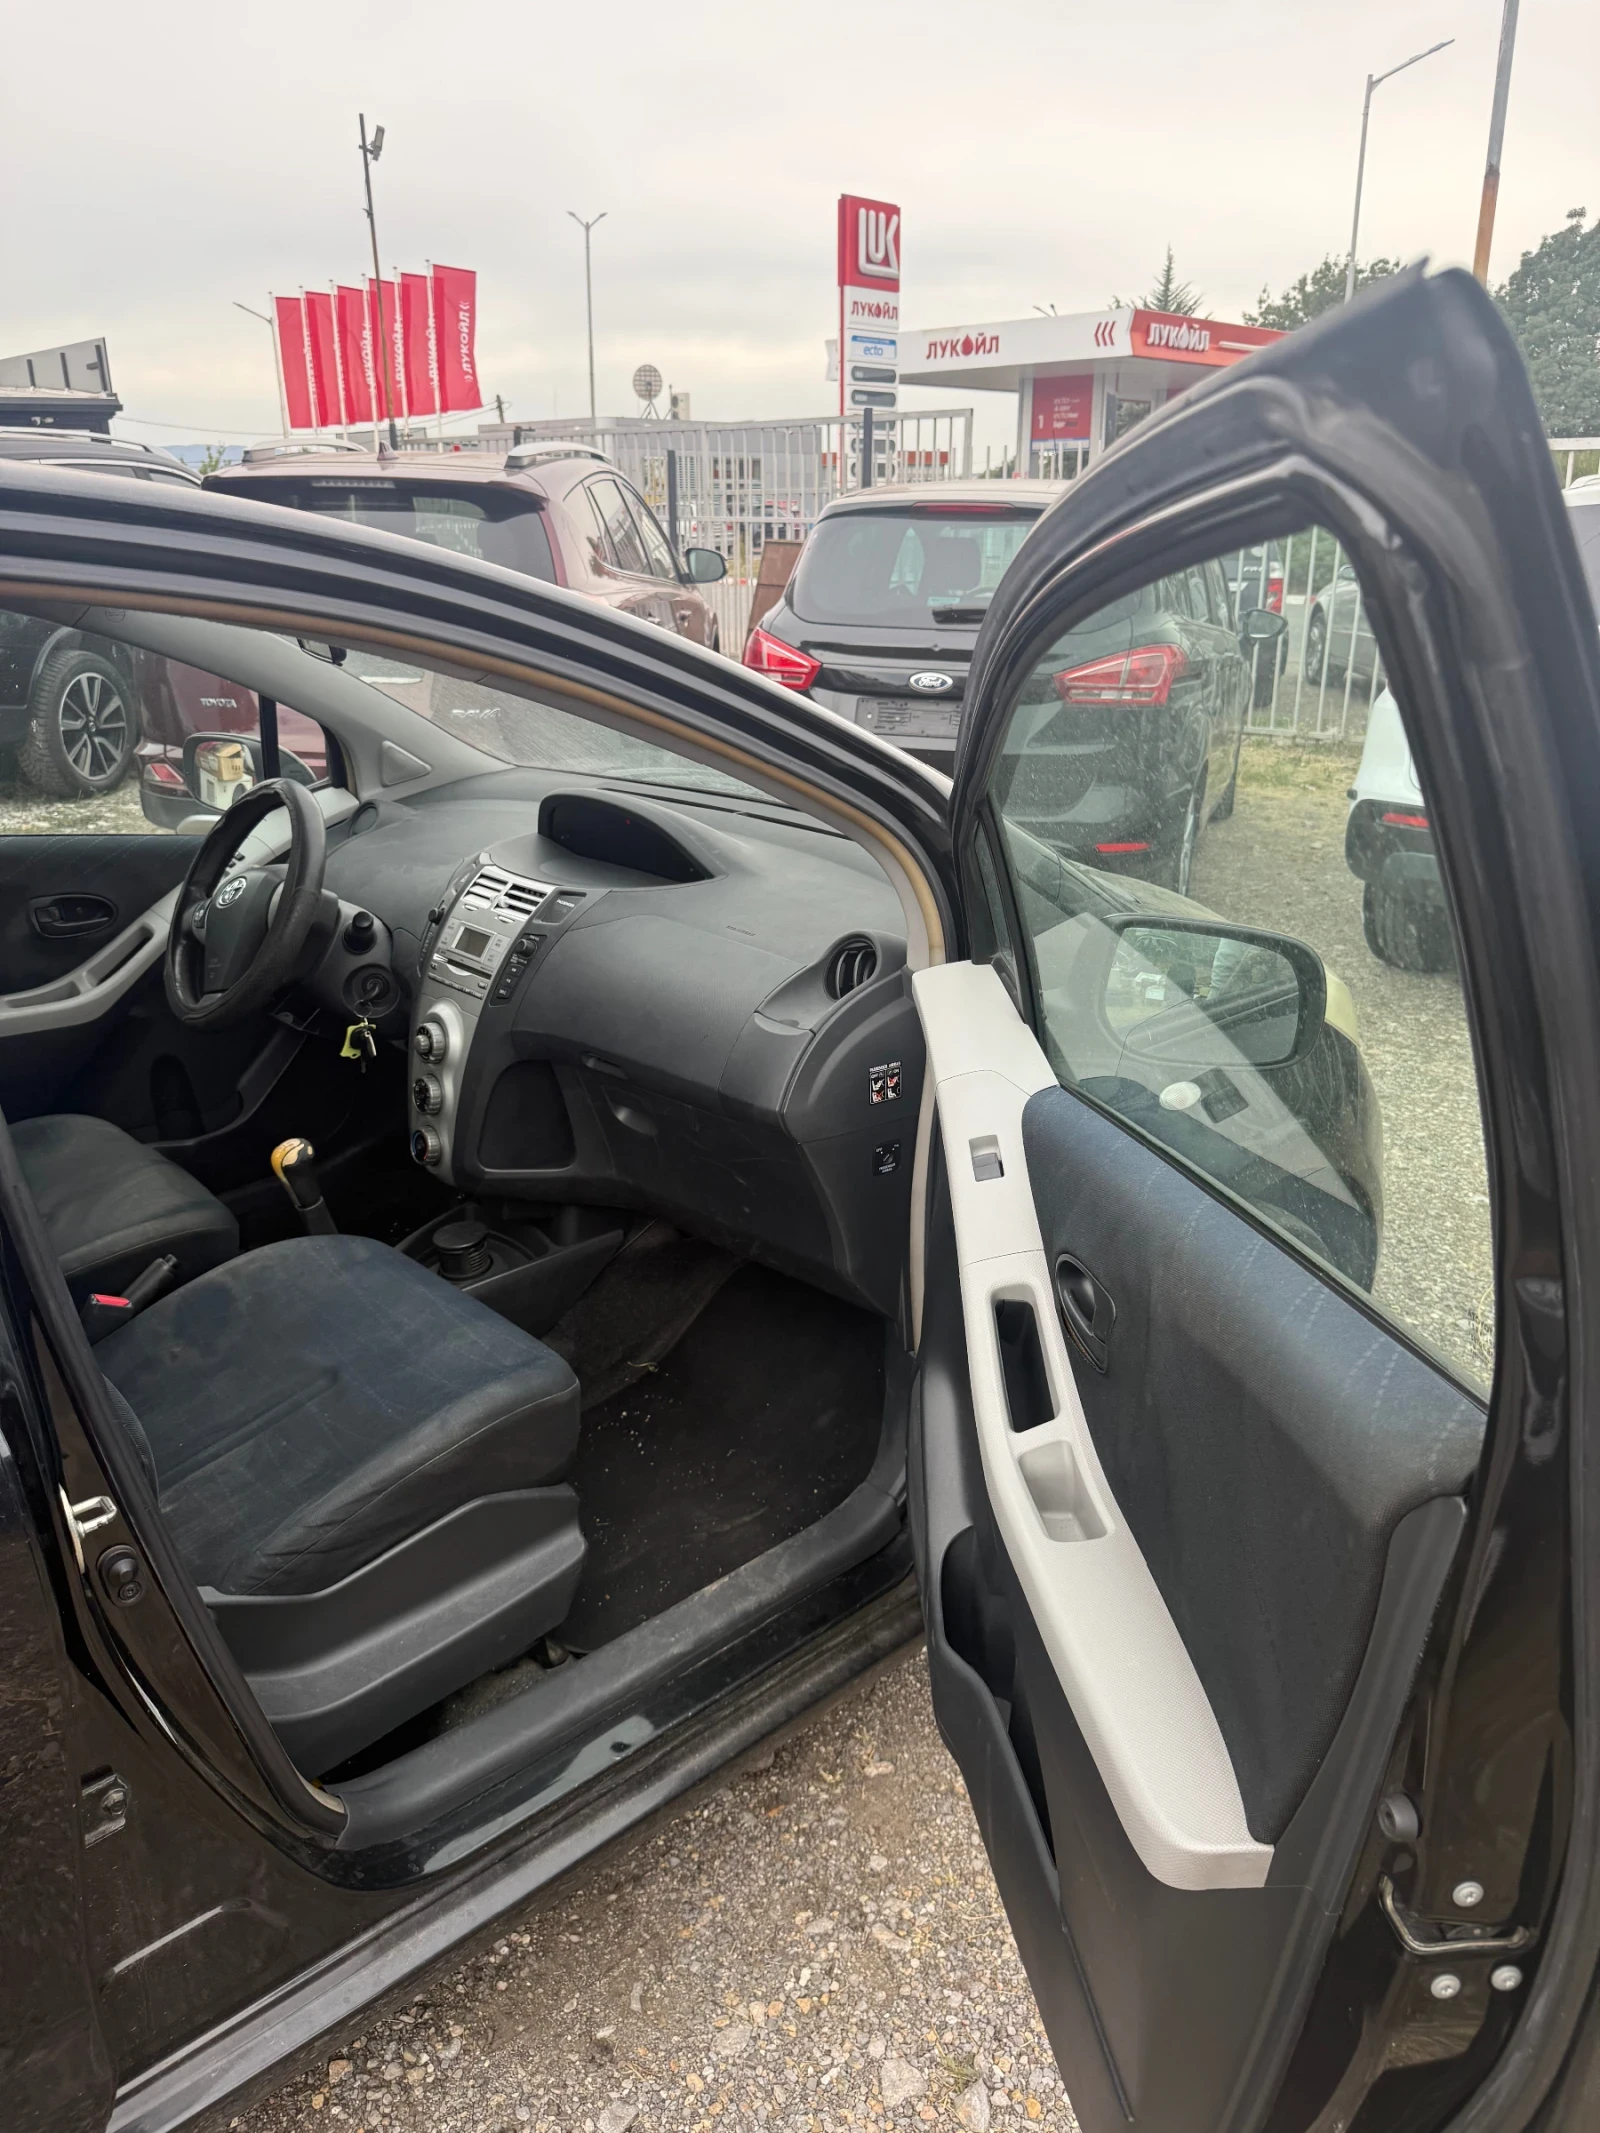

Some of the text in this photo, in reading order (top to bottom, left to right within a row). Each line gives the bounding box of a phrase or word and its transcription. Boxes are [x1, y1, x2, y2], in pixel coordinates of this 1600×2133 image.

[851, 300, 899, 321] ЛУКОЙЛ
[458, 310, 473, 374] ЛУКОЙЛ
[926, 332, 999, 360] ЛУКОЙЛ
[1147, 322, 1210, 352] ЛУКОЙЛ
[863, 345, 883, 356] ecto
[919, 676, 943, 687] Ford
[200, 698, 237, 708] TOYOTA
